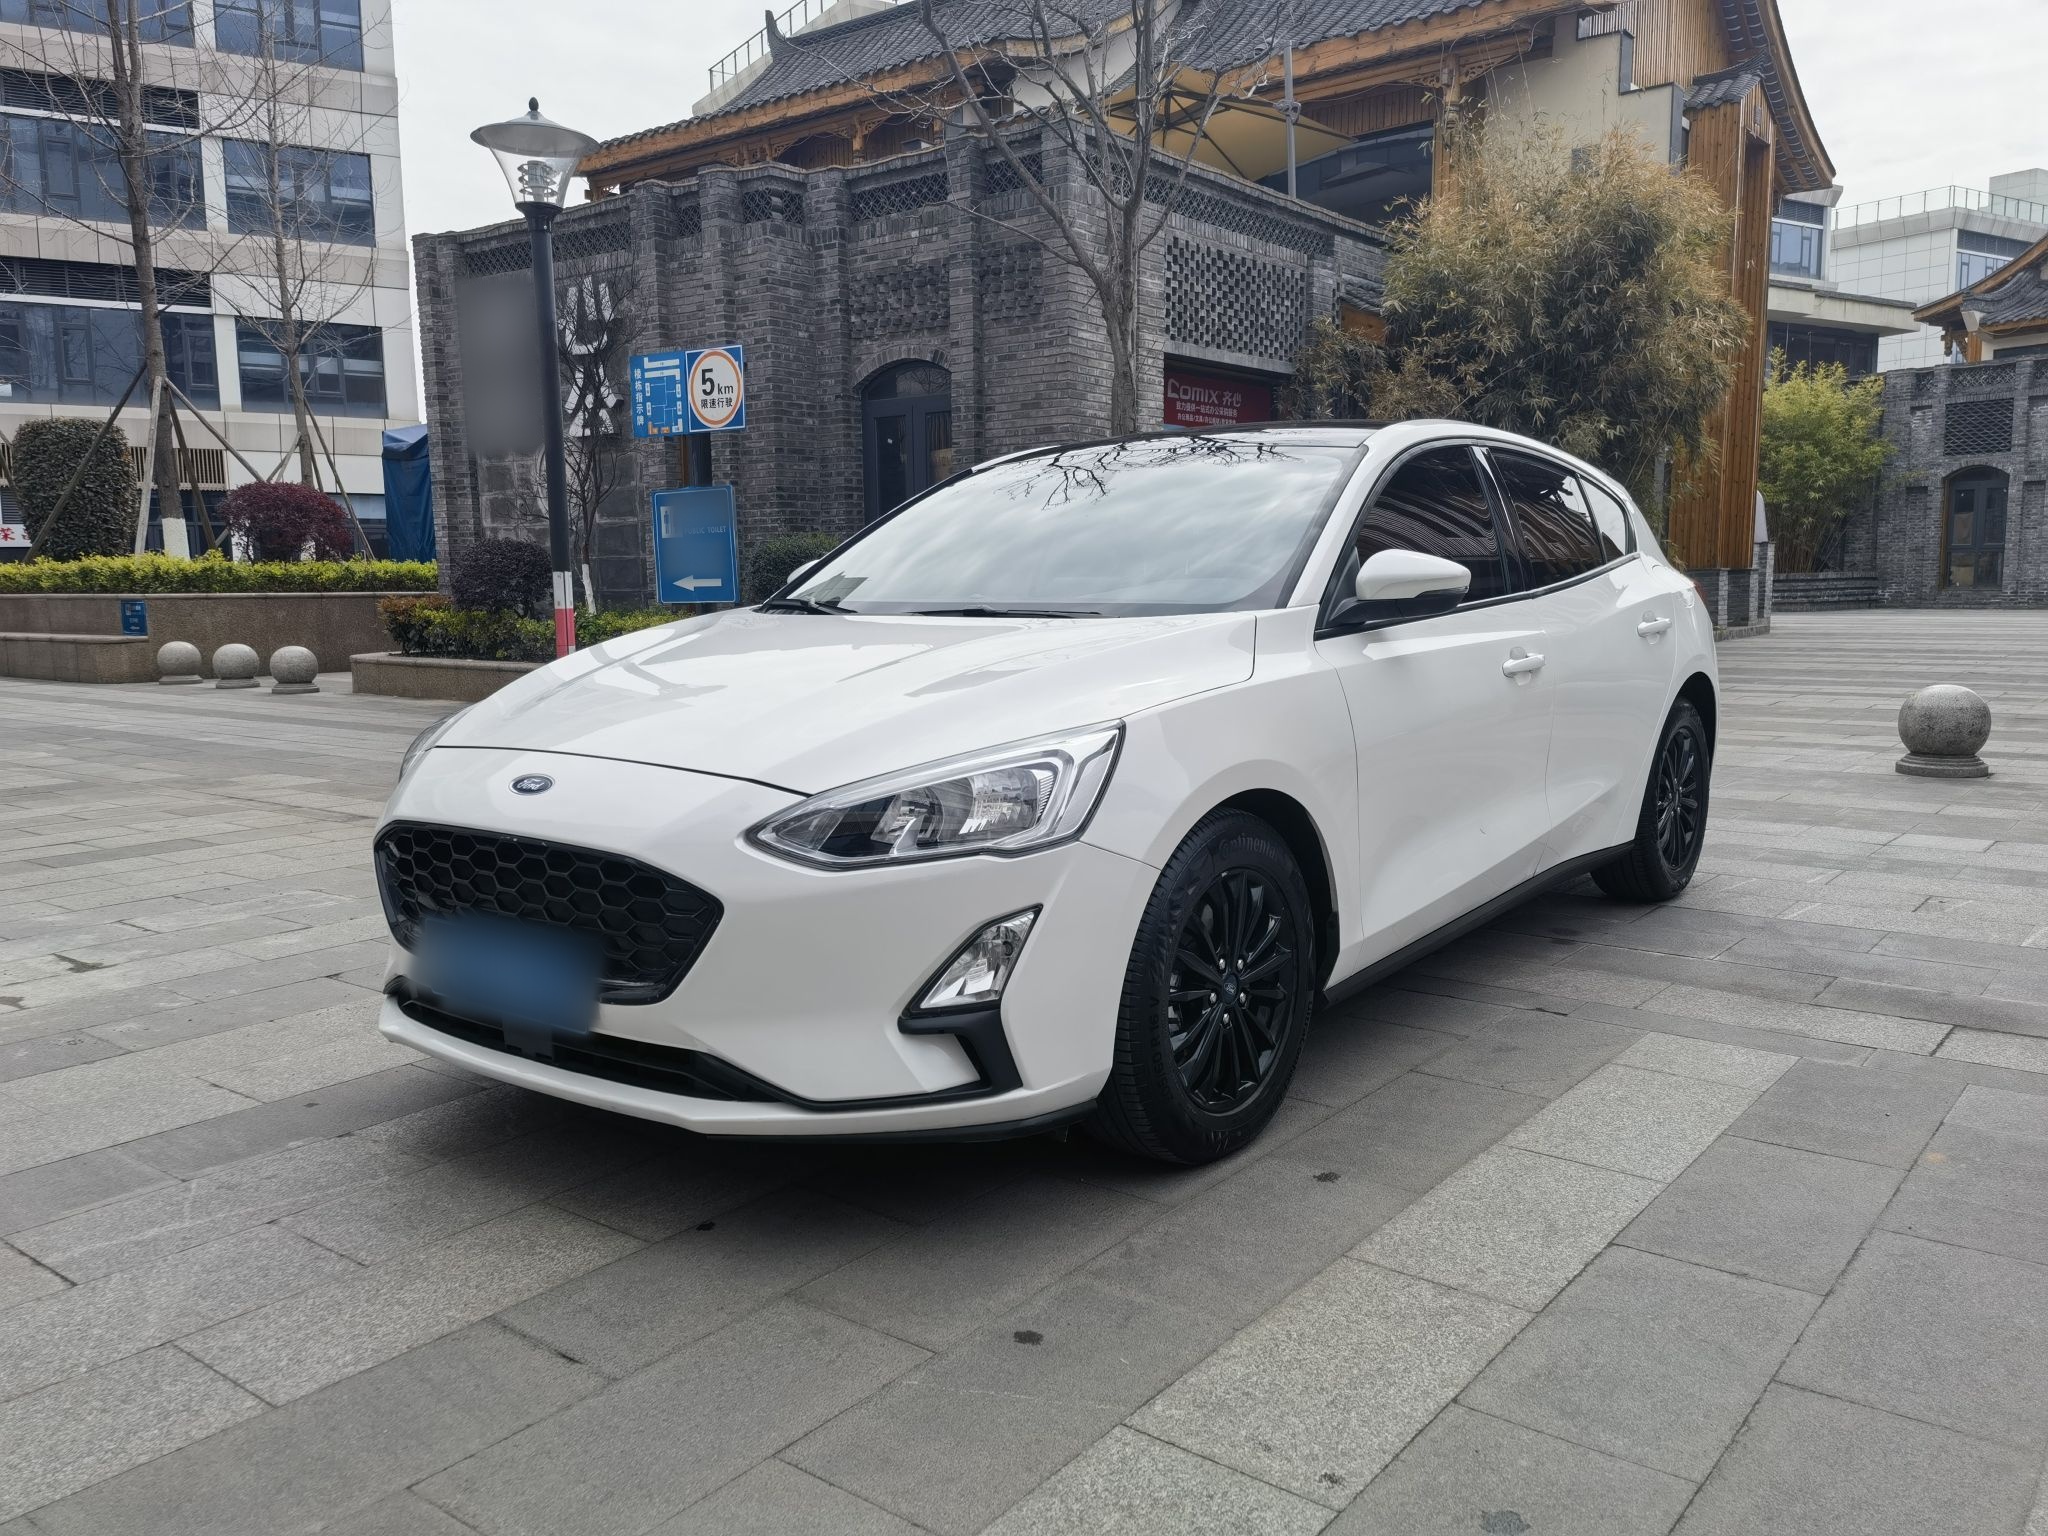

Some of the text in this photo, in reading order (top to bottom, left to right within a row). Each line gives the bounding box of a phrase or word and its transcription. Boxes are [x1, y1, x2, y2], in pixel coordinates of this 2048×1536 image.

[701, 368, 715, 396] 5
[717, 384, 734, 395] km
[700, 398, 733, 409] 限速行驶
[1222, 390, 1242, 407] 齐心
[707, 525, 727, 534] TOILET
